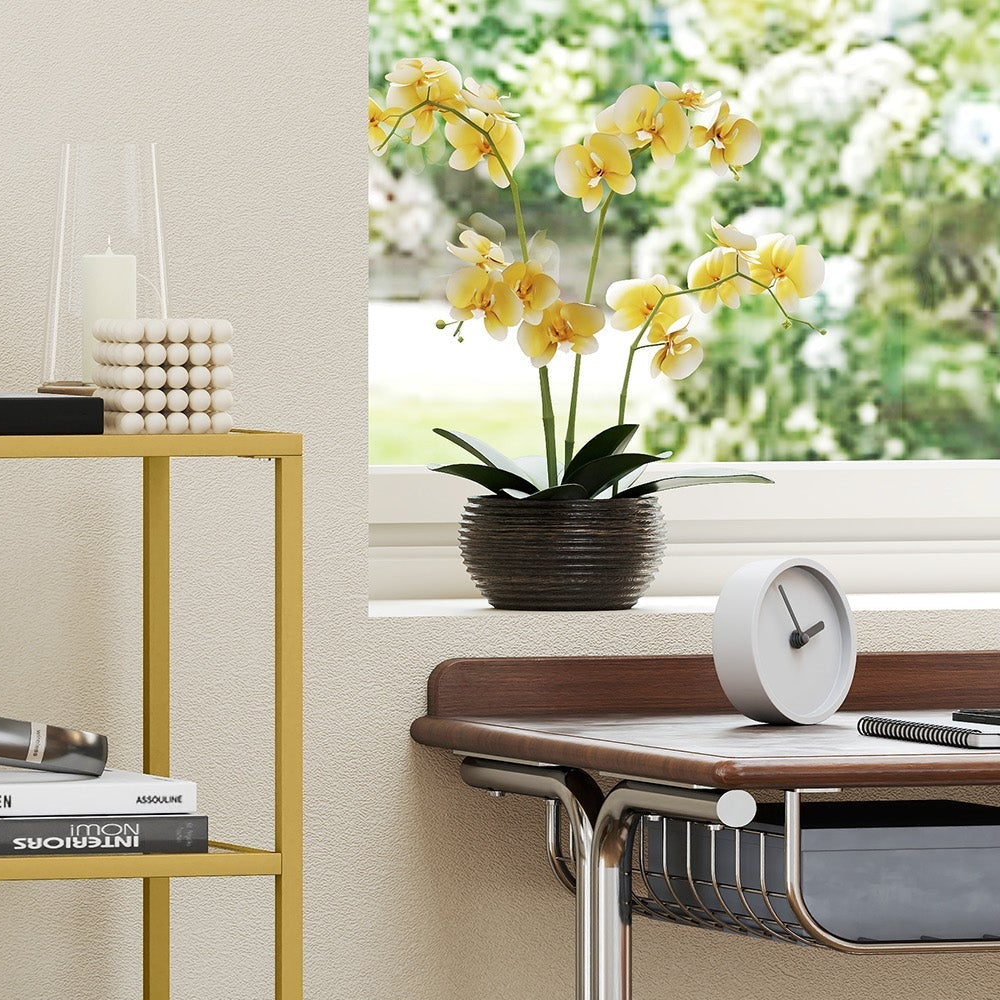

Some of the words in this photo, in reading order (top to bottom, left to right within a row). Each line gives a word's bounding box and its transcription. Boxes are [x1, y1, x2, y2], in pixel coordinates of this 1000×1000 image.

[136, 795, 182, 804] ASSOULINE
[70, 823, 139, 837] NOW!
[13, 836, 139, 850] INTERIORS
